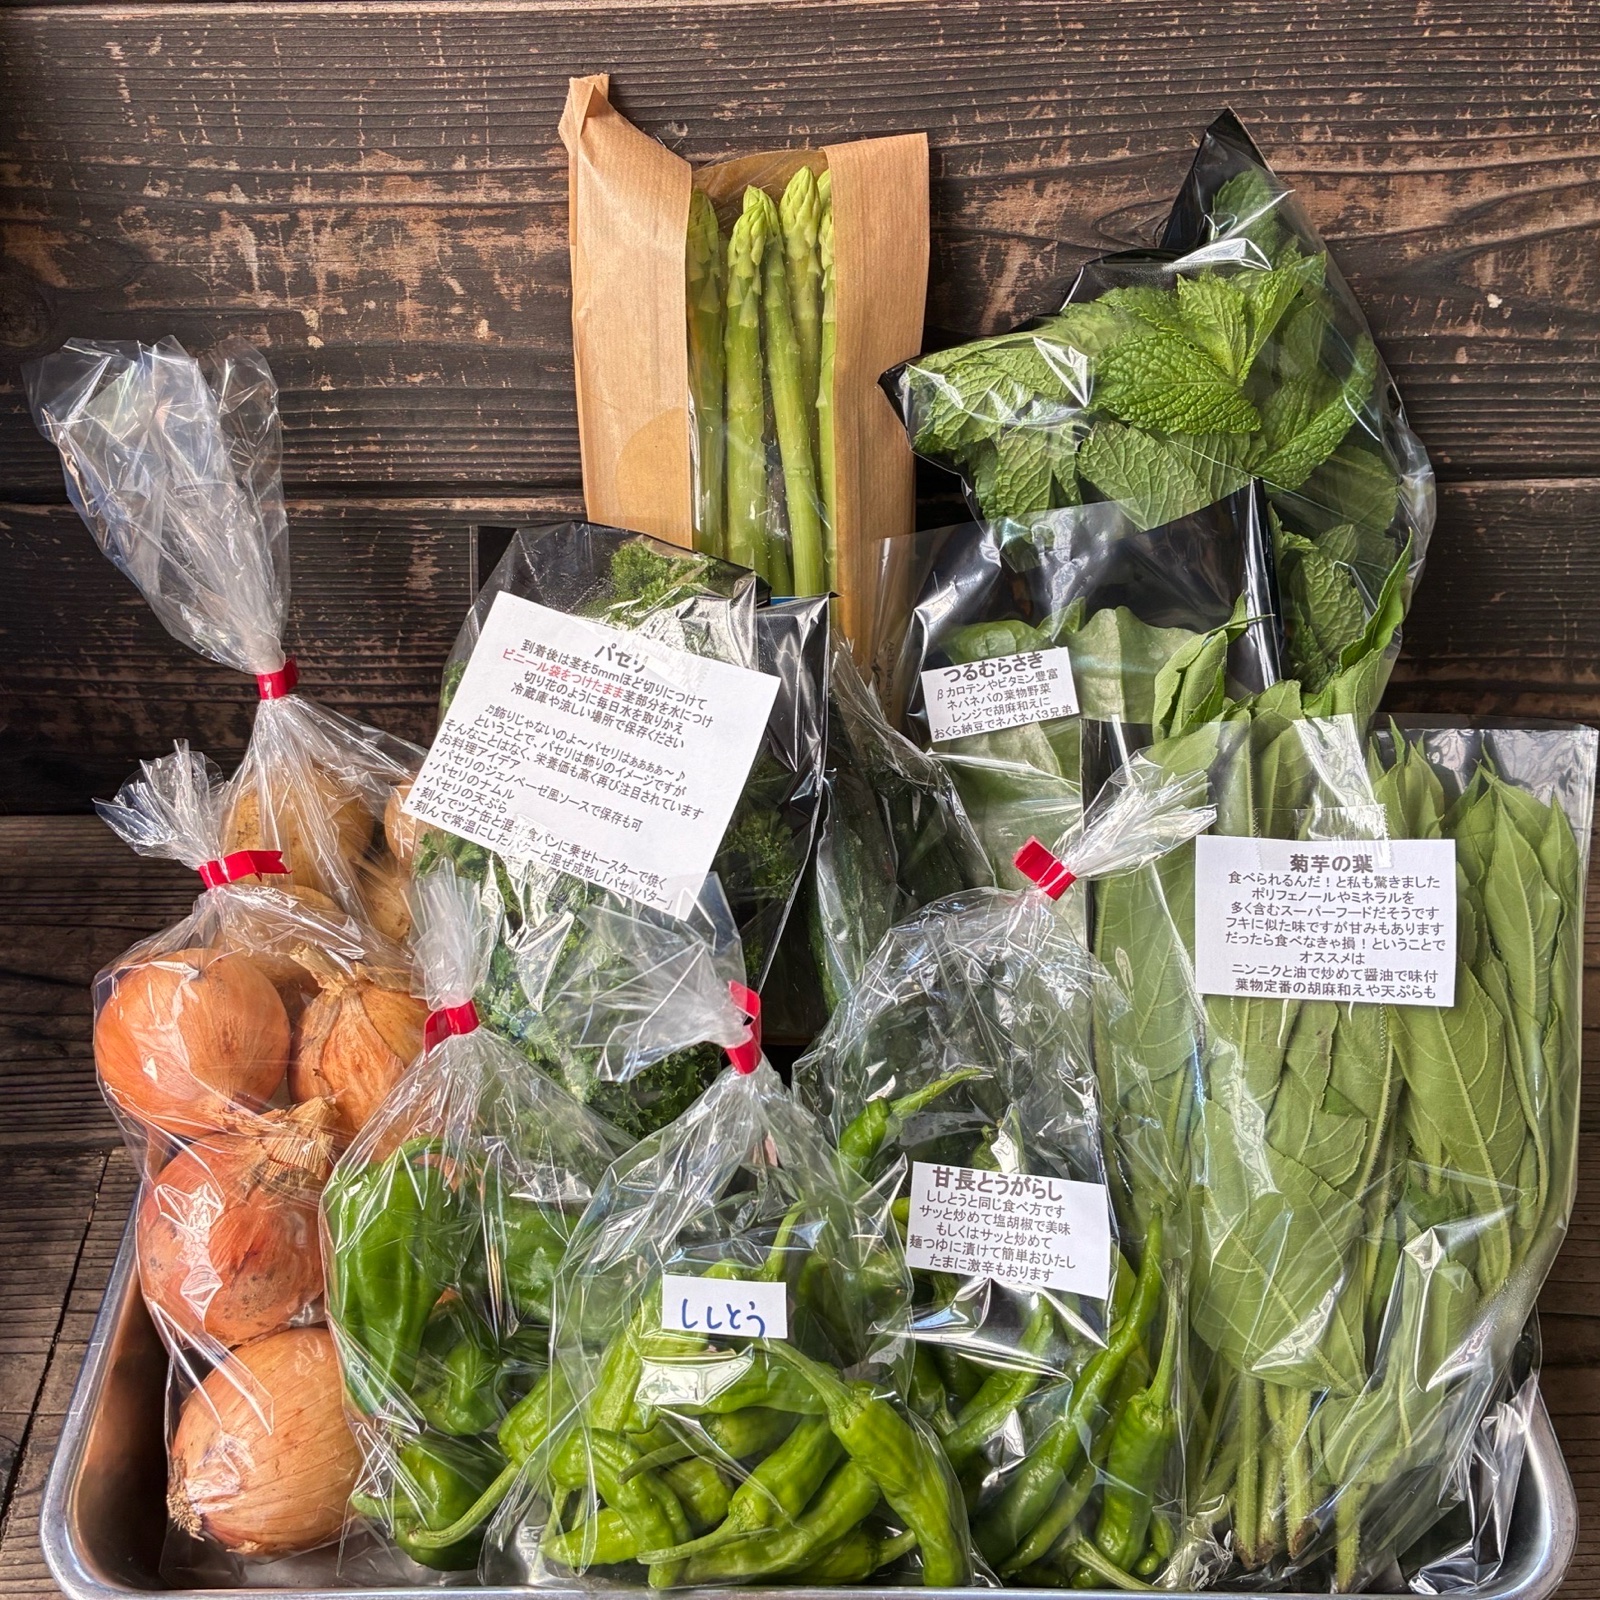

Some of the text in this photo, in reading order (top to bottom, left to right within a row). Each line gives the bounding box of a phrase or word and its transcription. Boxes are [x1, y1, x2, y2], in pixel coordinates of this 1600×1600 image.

[594, 643, 647, 674] パセリ
[943, 652, 1043, 683] つるむらさき
[502, 648, 713, 728] ビニール袋をつけたまま茎部分を水につけ
[521, 638, 708, 710] 到着後は茎を5mmほど切りにつけて
[524, 670, 682, 735] 切り花のように毎日水を取りかえ
[947, 683, 1052, 711] ネバネバの葉物野菜
[952, 696, 1051, 723] レンジで胡麻和えに
[510, 682, 685, 748] 冷蔵庫や涼しい場所で保存ください
[934, 704, 1073, 740] おくら納豆でネバネバ3兄弟
[439, 732, 521, 768] お料理アイデア
[474, 715, 686, 797] ということで、パセリは飾りのイメージですが
[445, 719, 704, 820] そんなことはなく、栄養価も高く再び注目されています
[1290, 854, 1374, 873] 菊芋の葉
[1228, 871, 1441, 890] 食べられるんだ！と私も驚きました
[1231, 902, 1440, 920] 多く含むスーパーフードだそうです
[1251, 889, 1415, 905] ポリフェノールやミネラルを
[1226, 917, 1444, 935] フキに似た味ですが甘みもあります
[1225, 931, 1446, 952] だったら食べなきゃ損！ということで
[1299, 951, 1365, 965] オススメは
[1231, 964, 1439, 984] ニンニクと油で炒めて醤油で味付
[1235, 978, 1436, 999] 葉物定番の胡麻和えや天ぷらも
[932, 1166, 1063, 1201] 甘長とうがらし
[926, 1189, 1065, 1219] ししとうと同じ食べ方です
[919, 1204, 1071, 1236] サッと炒めて塩胡椒で美味
[936, 1221, 1053, 1250] もしくはサッと炒めて
[909, 1234, 1076, 1270] 麺つゆに漬けて簡単おひたし
[929, 1253, 1054, 1282] たまに激辛もおります
[681, 1298, 766, 1338] ししとう
